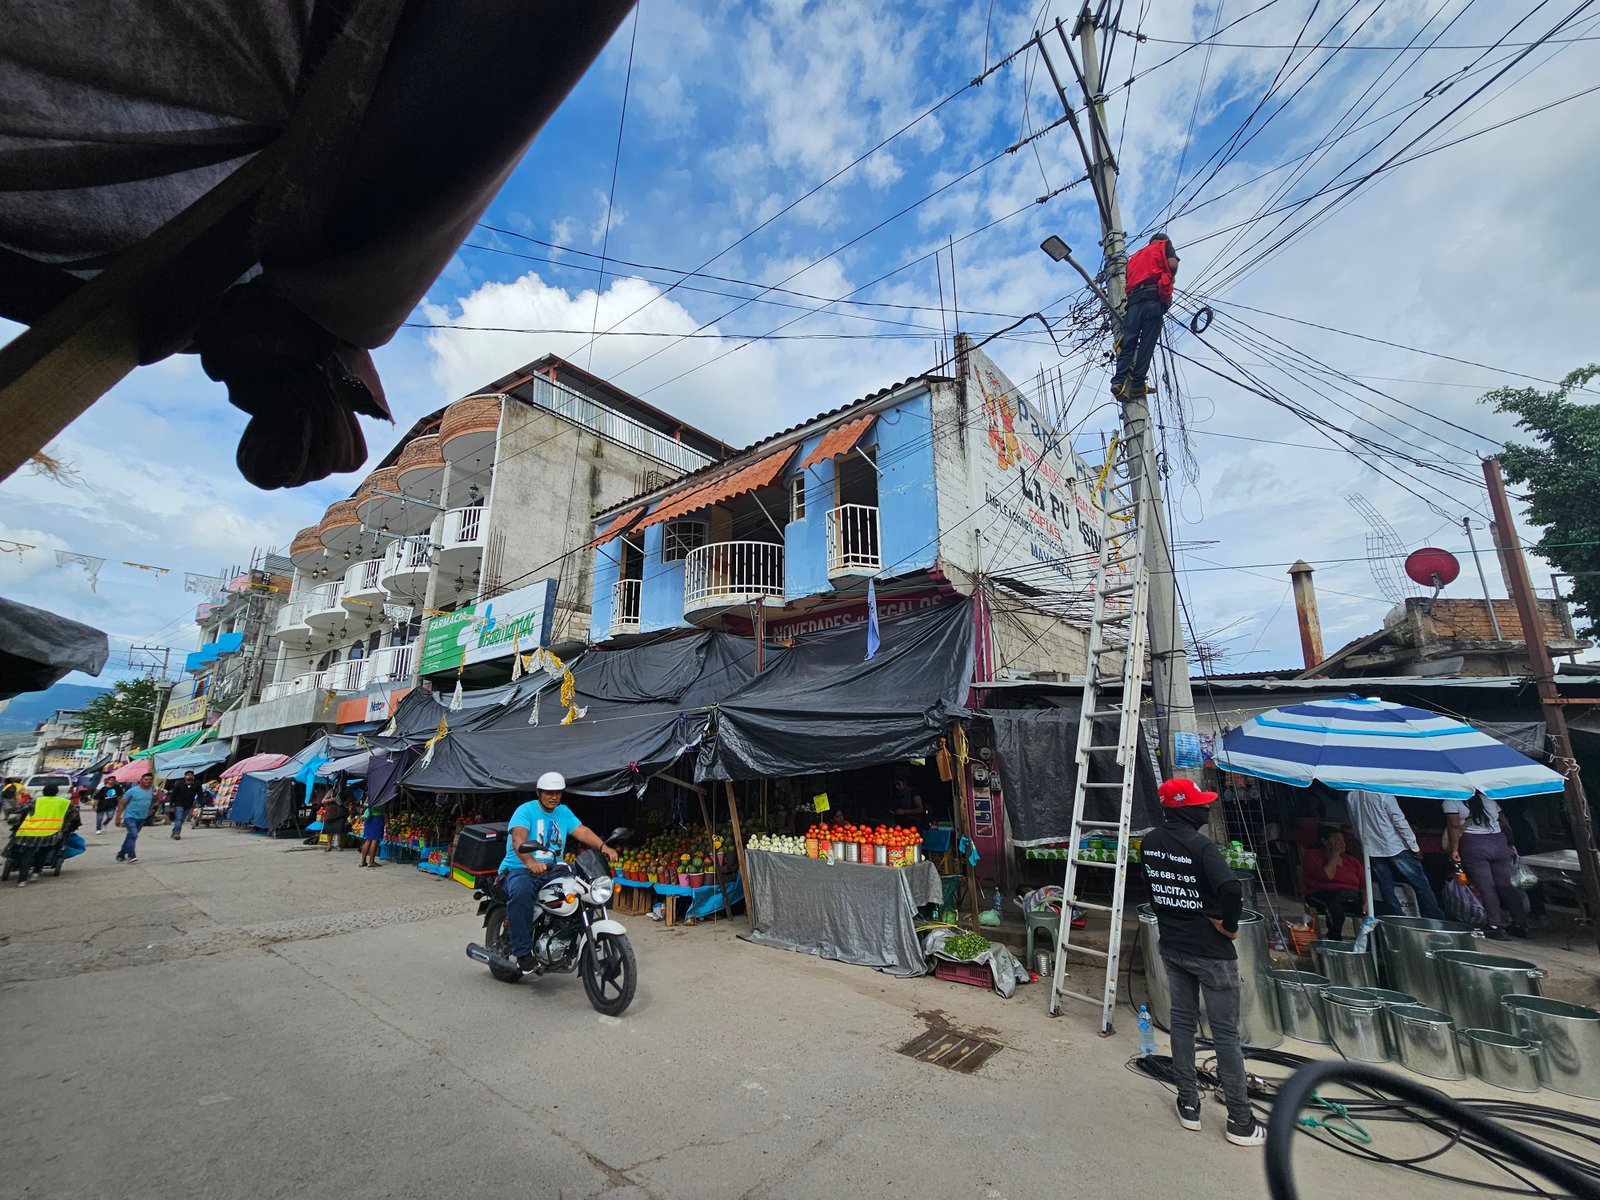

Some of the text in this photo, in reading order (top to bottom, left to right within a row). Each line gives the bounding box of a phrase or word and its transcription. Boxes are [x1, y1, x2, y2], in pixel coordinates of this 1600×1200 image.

[1019, 465, 1046, 512] LA
[1151, 883, 1200, 898] SOLICITA TU
